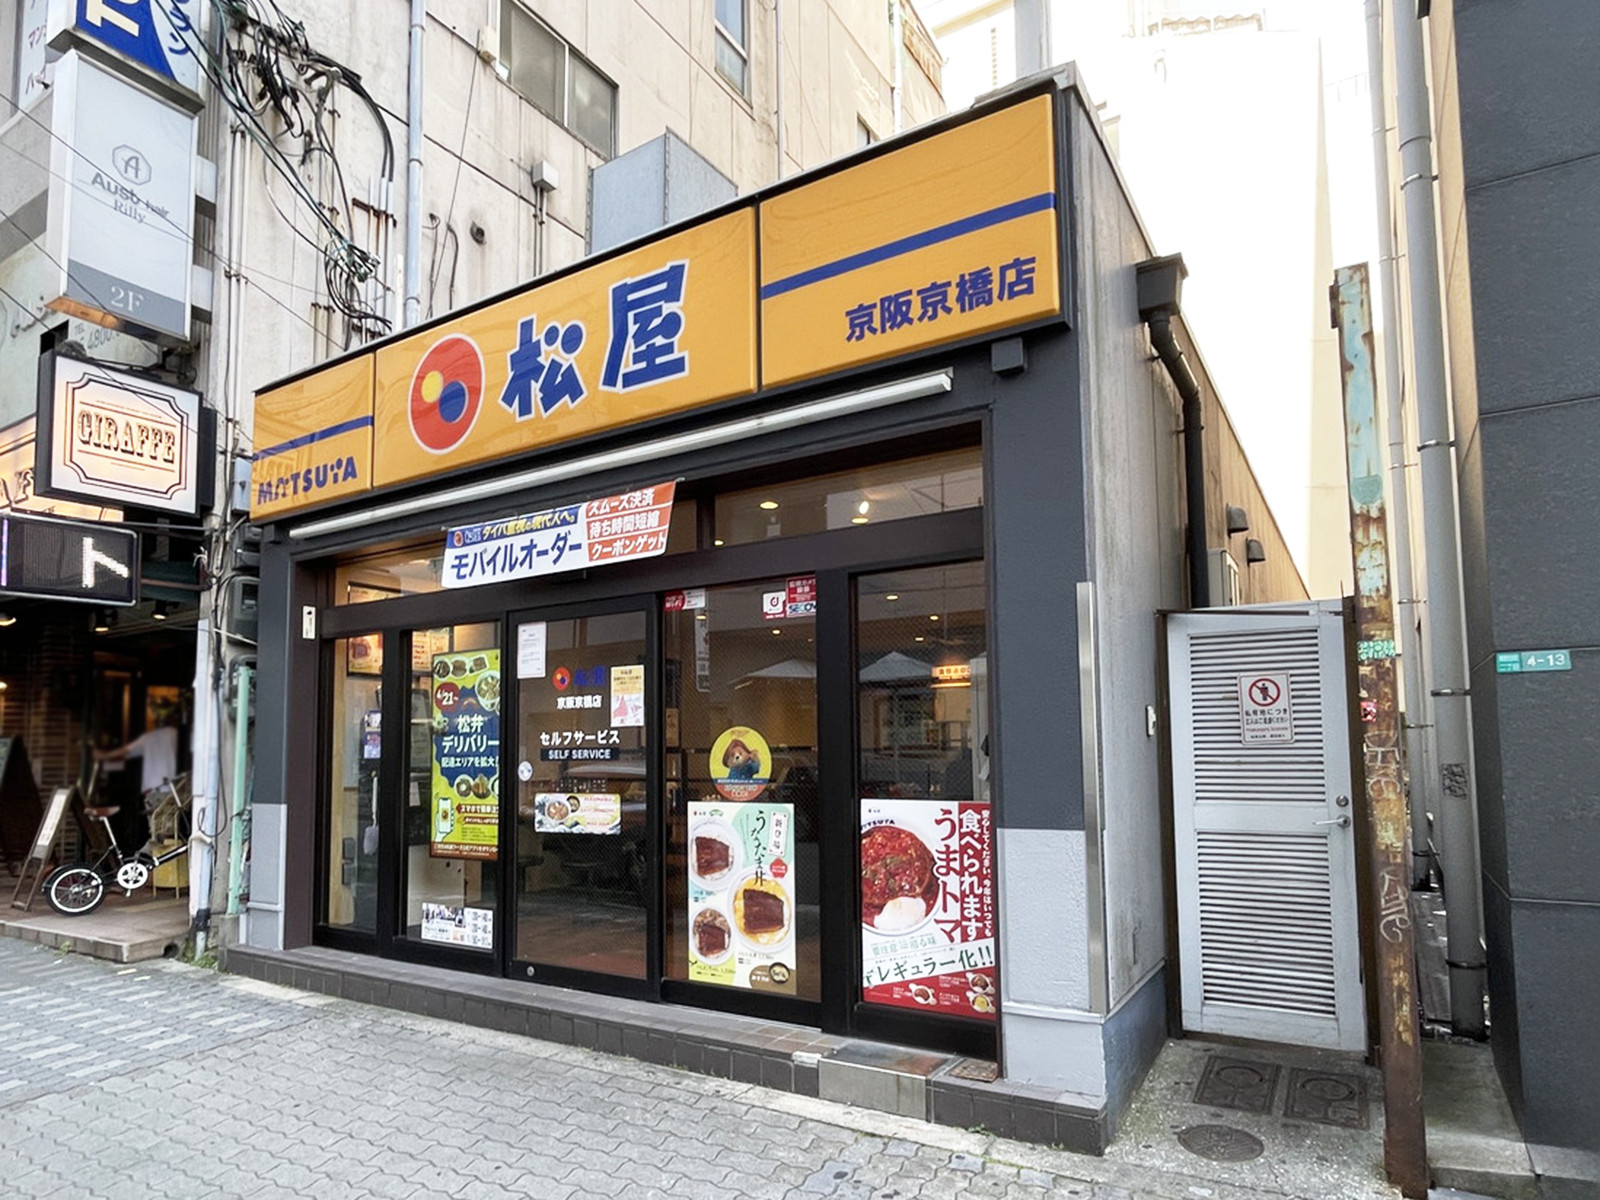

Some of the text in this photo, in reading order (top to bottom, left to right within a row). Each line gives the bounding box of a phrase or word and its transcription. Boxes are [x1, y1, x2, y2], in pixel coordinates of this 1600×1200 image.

[111, 286, 144, 311] 2F
[845, 256, 1036, 342] 京阪京橋店
[500, 260, 688, 421] 松屋
[77, 409, 176, 464] GIRAFFE
[257, 456, 357, 505] MATSUYA
[588, 488, 655, 517] スムーズ決済
[590, 510, 660, 540] 待ち時間短縮
[450, 530, 583, 580] モバイルオーダー
[592, 532, 666, 560] クーポンゲット
[1527, 653, 1565, 667] 4-13
[442, 734, 500, 754] デリバリー
[540, 730, 620, 746] セルフサービス
[548, 748, 611, 760] SELF SERVICE
[934, 808, 960, 943] うまトマ
[959, 808, 983, 941] 食べられます
